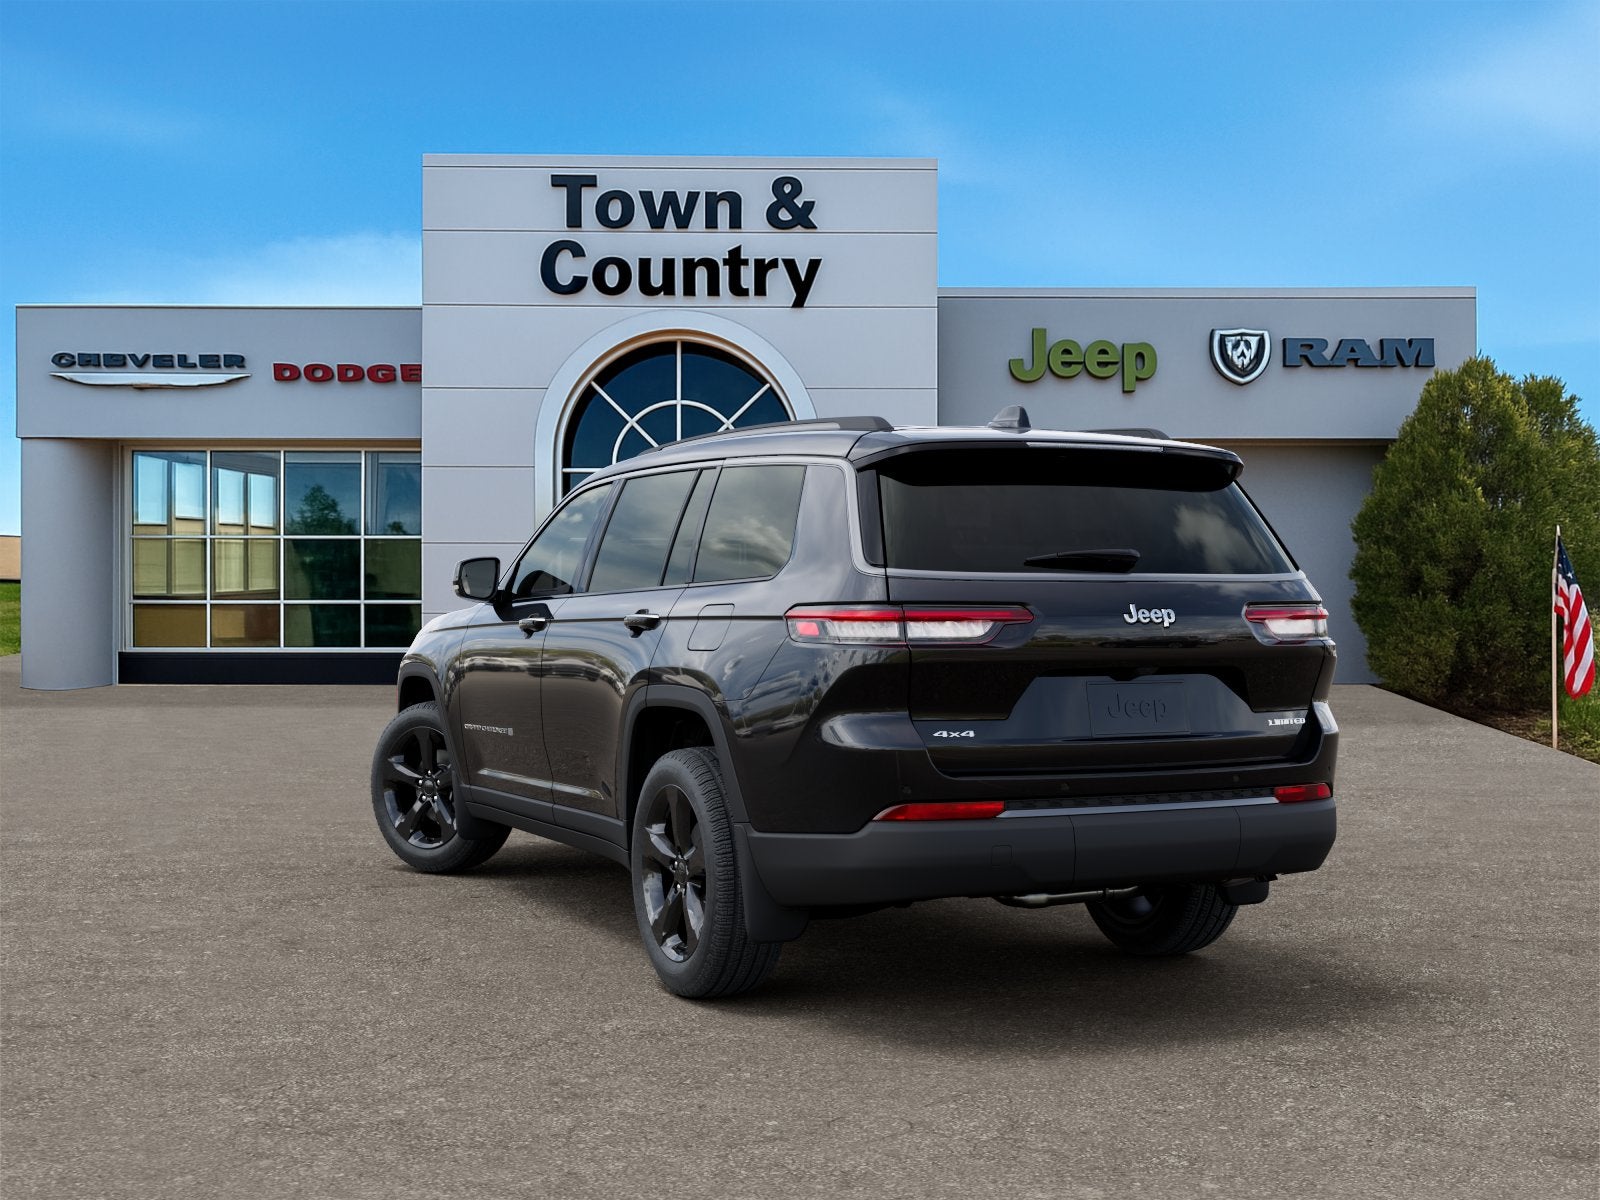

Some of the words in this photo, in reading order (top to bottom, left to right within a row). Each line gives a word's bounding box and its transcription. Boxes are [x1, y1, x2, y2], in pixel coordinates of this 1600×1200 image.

[550, 174, 742, 229] Town
[765, 176, 818, 230] &
[540, 239, 823, 308] Country
[1008, 328, 1157, 393] Jeep
[1282, 337, 1436, 368] RAM
[272, 362, 422, 384] DODGE
[1123, 603, 1176, 628] Jeep
[1106, 691, 1167, 724] Jeep
[932, 730, 976, 738] 4x4
